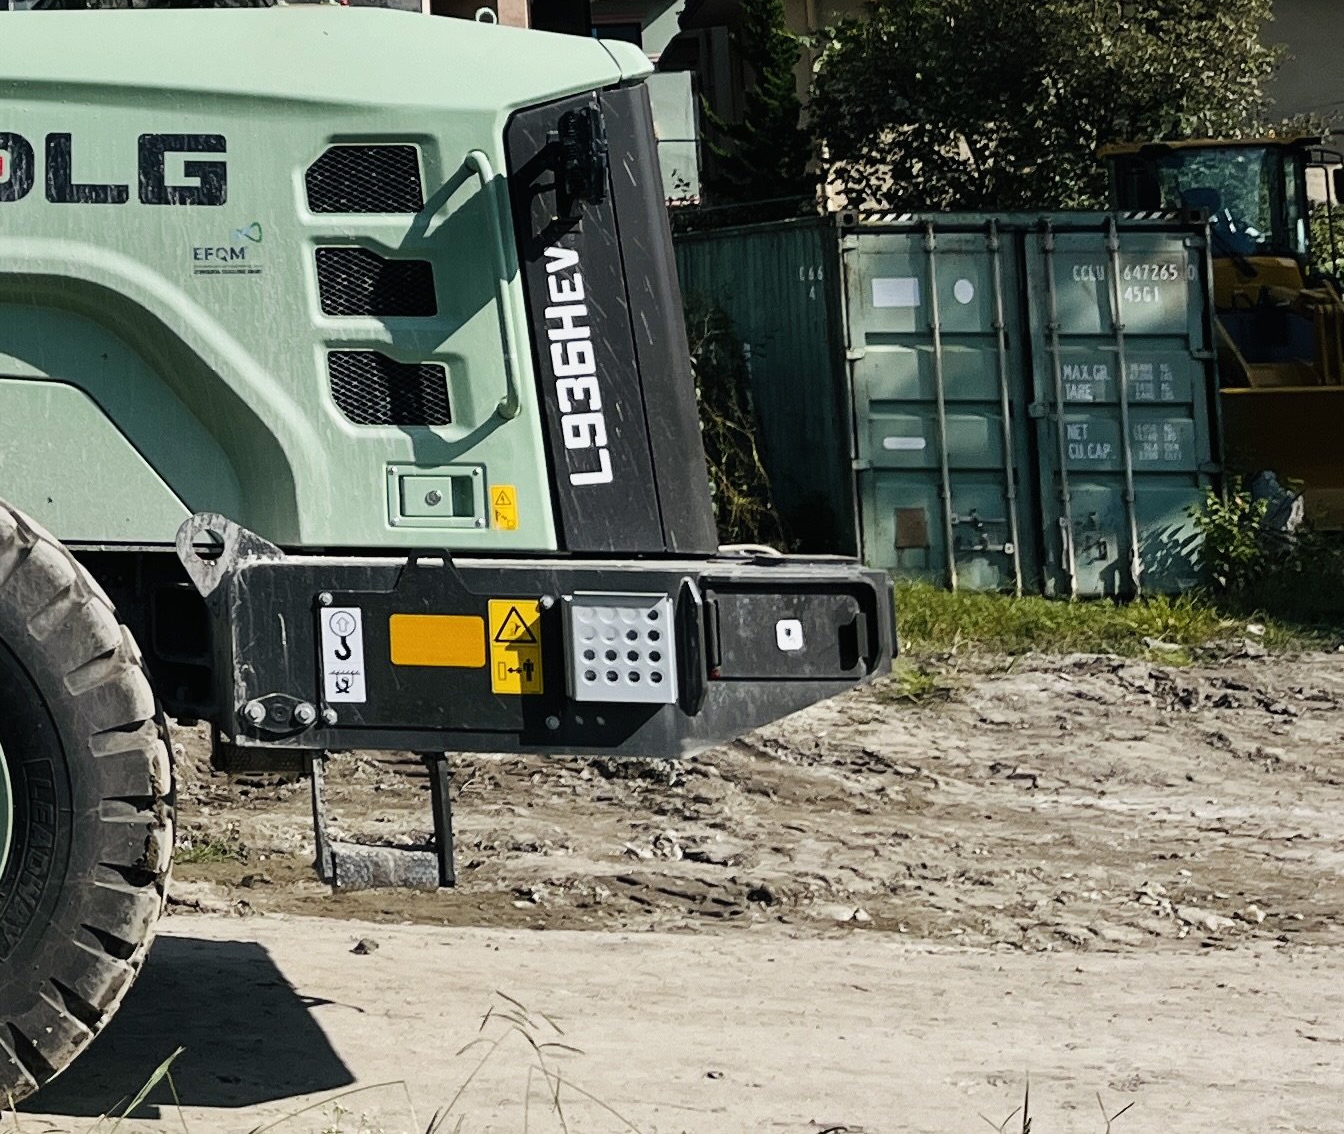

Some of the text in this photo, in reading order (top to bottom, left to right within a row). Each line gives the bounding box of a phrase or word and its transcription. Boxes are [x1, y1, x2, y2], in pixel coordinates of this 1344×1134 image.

[192, 247, 246, 262] EFQM
[1123, 263, 1179, 282] 647265
[543, 244, 614, 487] L936HEV
